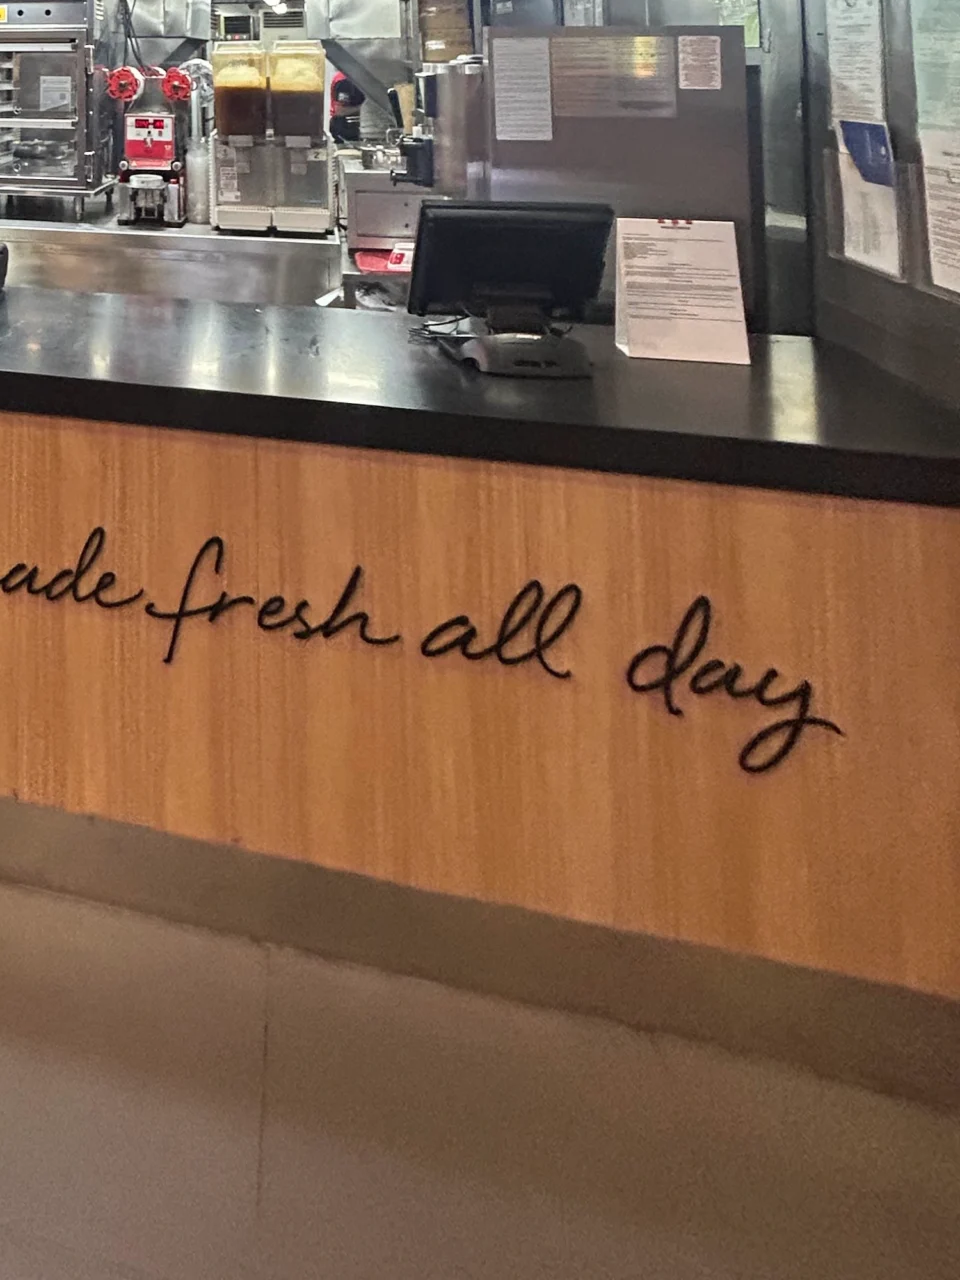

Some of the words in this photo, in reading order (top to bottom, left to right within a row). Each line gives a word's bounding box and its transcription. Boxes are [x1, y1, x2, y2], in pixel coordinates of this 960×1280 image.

[145, 535, 400, 664] fresh
[420, 580, 583, 681] all
[626, 595, 844, 774] day
